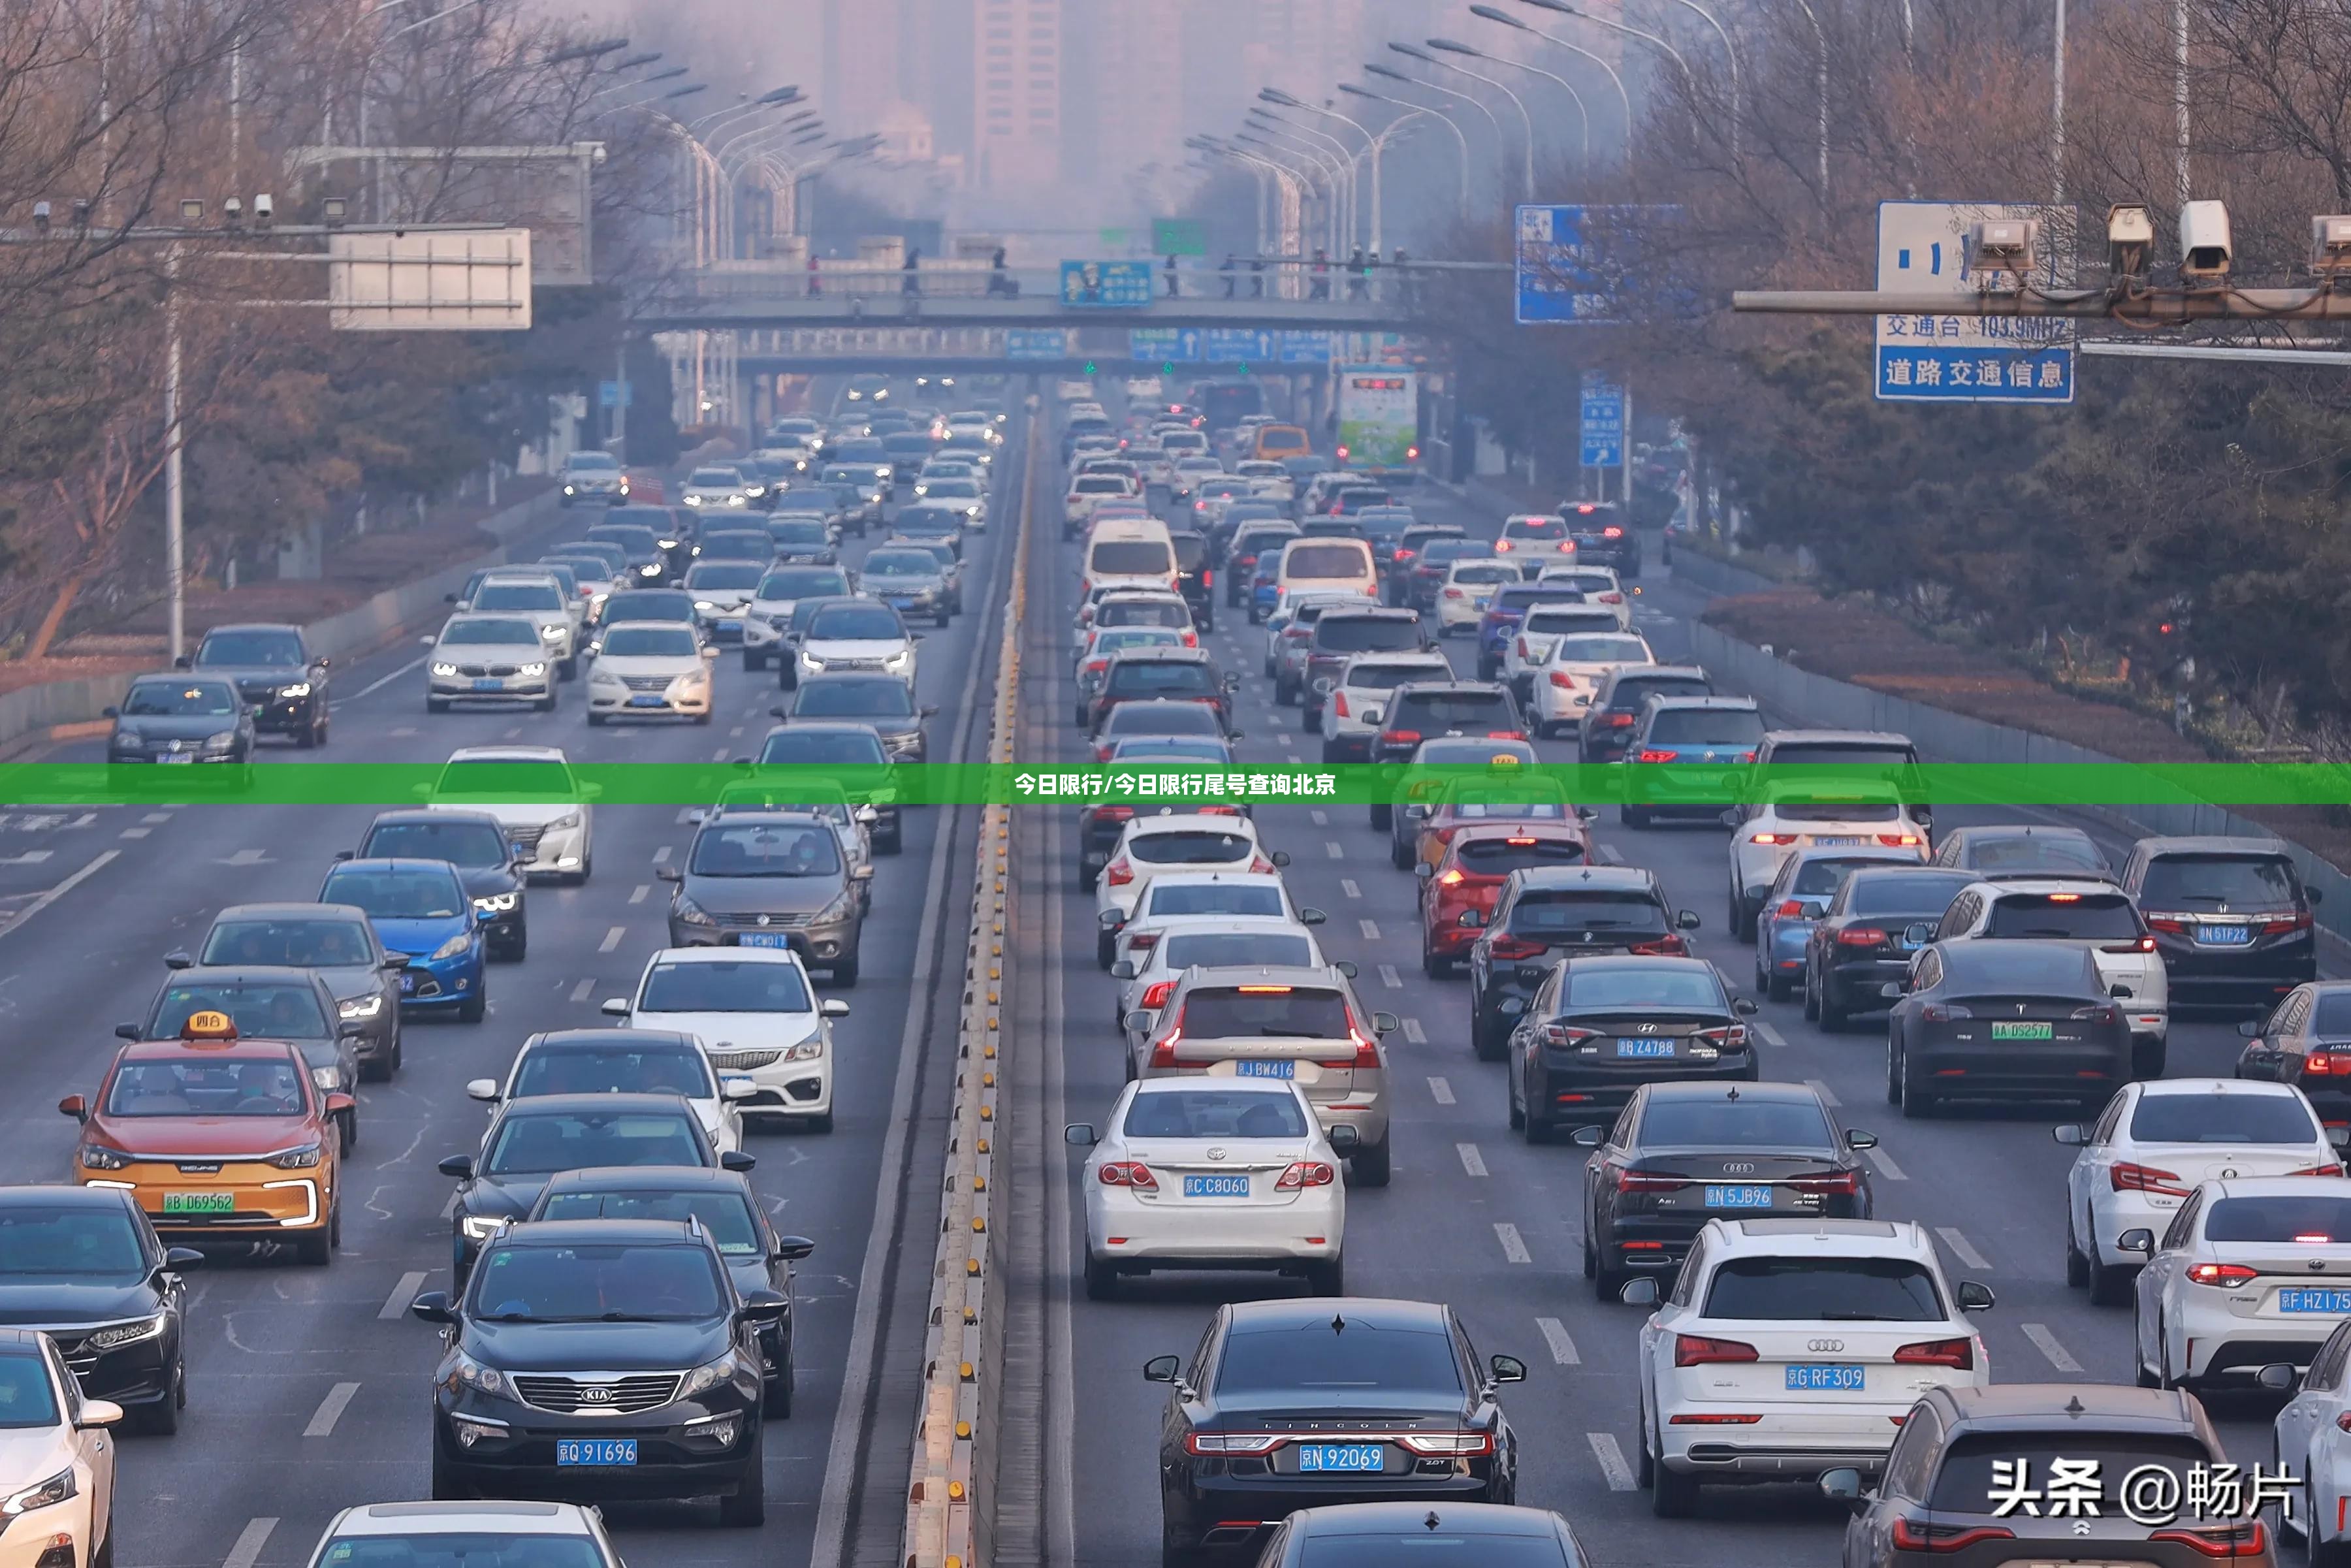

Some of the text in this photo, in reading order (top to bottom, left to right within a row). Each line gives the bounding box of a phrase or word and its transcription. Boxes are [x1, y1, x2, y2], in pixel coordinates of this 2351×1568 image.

[1886, 359, 2064, 388] 道路交通信息
[586, 1390, 608, 1400] KIA
